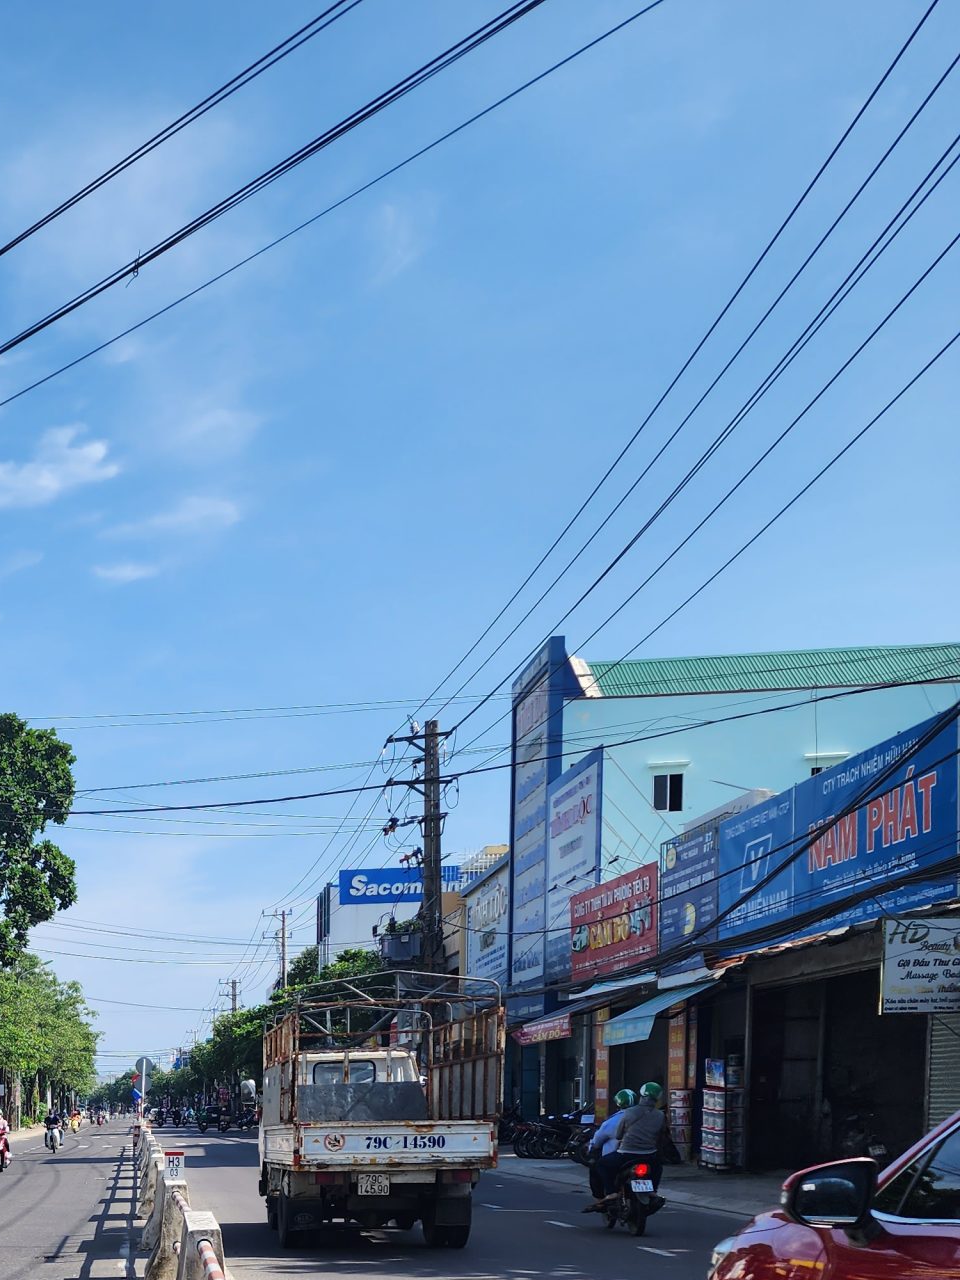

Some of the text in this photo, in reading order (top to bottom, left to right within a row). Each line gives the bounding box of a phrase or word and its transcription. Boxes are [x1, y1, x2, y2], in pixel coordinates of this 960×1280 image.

[808, 764, 937, 874] NAM PHÁT
[590, 911, 613, 950] CẦM
[900, 970, 938, 983] Massage
[168, 1156, 180, 1167] H3
[170, 1168, 178, 1177] 03
[365, 1174, 383, 1184] 79C
[359, 1184, 389, 1195] 145.90
